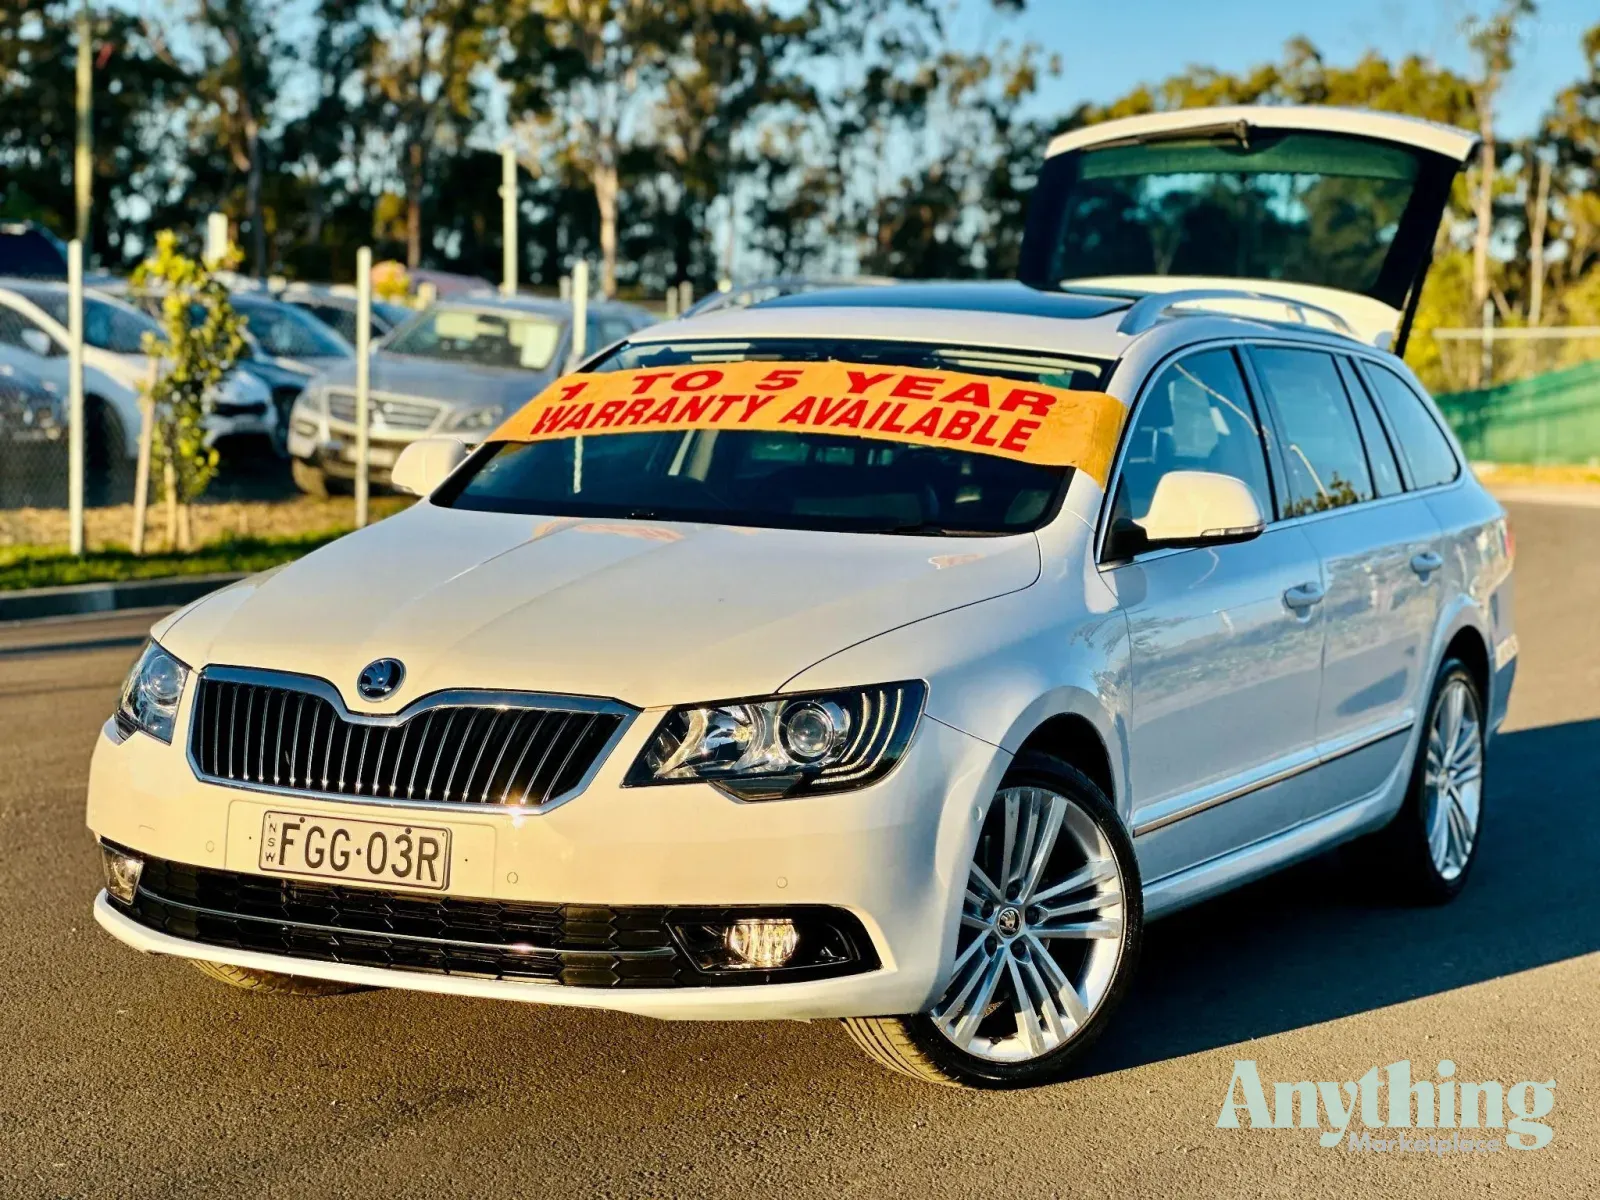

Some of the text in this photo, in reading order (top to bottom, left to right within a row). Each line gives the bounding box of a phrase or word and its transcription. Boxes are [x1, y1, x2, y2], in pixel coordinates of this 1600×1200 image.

[559, 370, 1058, 417] 1 TO 5 YEAR
[530, 395, 1042, 453] WARRANTY AVAILABLE
